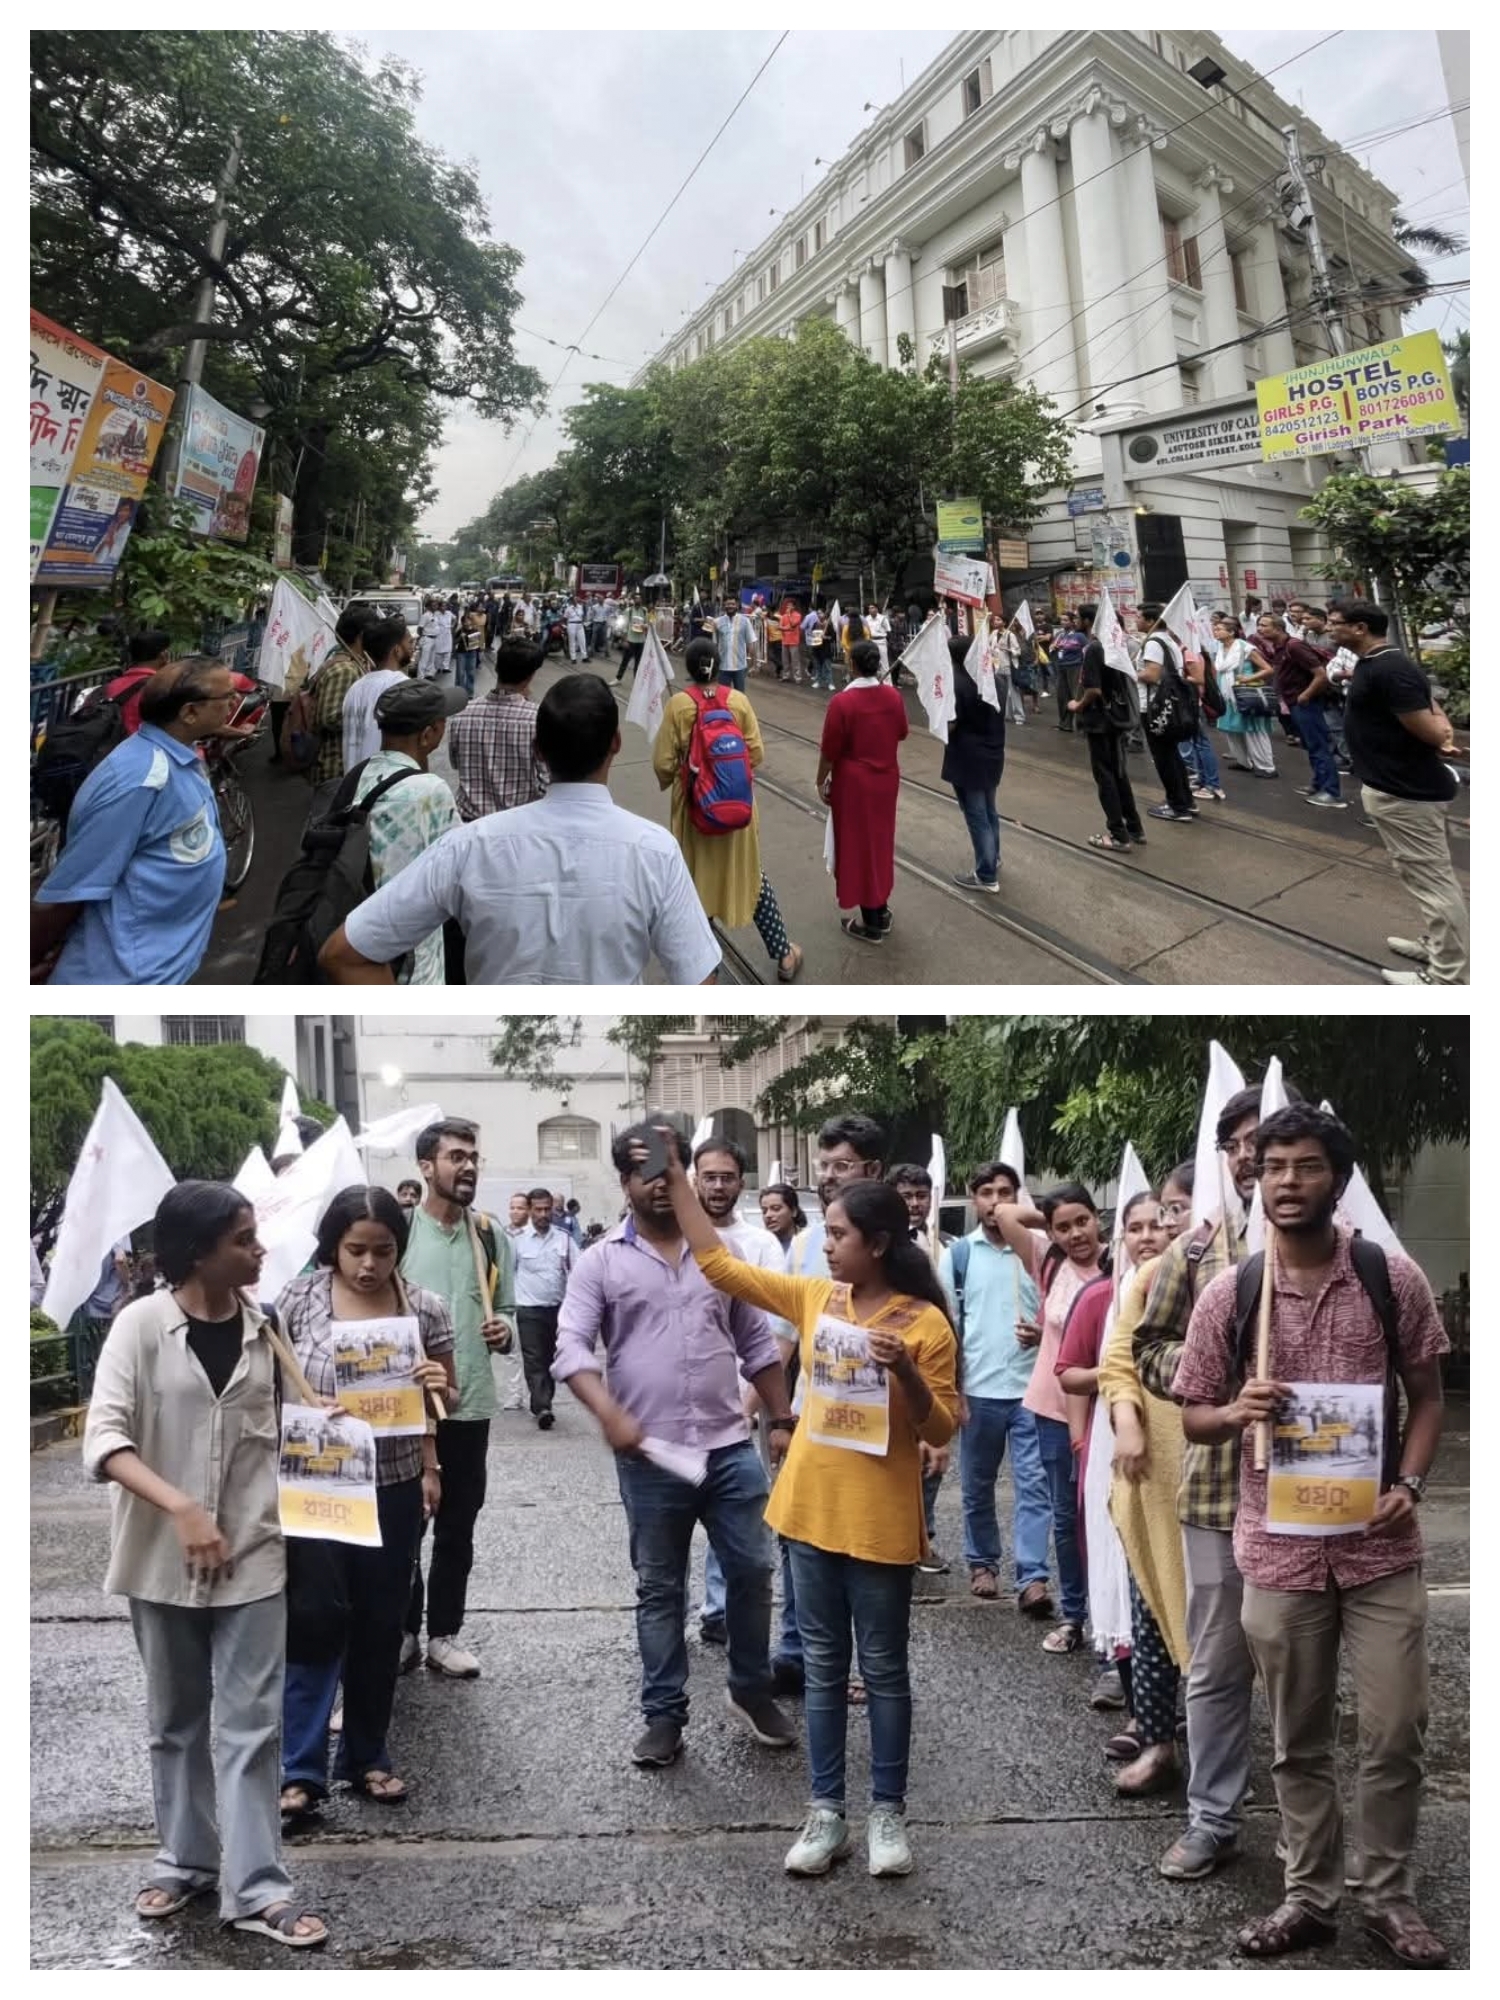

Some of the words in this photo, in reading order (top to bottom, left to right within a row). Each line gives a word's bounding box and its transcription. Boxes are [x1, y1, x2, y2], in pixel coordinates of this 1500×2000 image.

[1284, 344, 1402, 385] JHUNJHUNWALA
[1289, 359, 1403, 401] HOSTEL
[1356, 379, 1401, 402] BOYS
[1407, 371, 1442, 389] P.G.
[1263, 402, 1305, 423] GIRLS
[1309, 395, 1337, 413] P.G.
[1359, 387, 1445, 417] 8017260810
[1163, 422, 1218, 444] UNIVERSITY
[1220, 420, 1234, 432] OF
[1237, 415, 1259, 429] CAL
[1265, 410, 1340, 436] 8420512123
[1295, 424, 1352, 444] Girish
[1358, 413, 1408, 432] Park
[1167, 440, 1206, 454] ASUTOSH
[1245, 429, 1261, 440] PR
